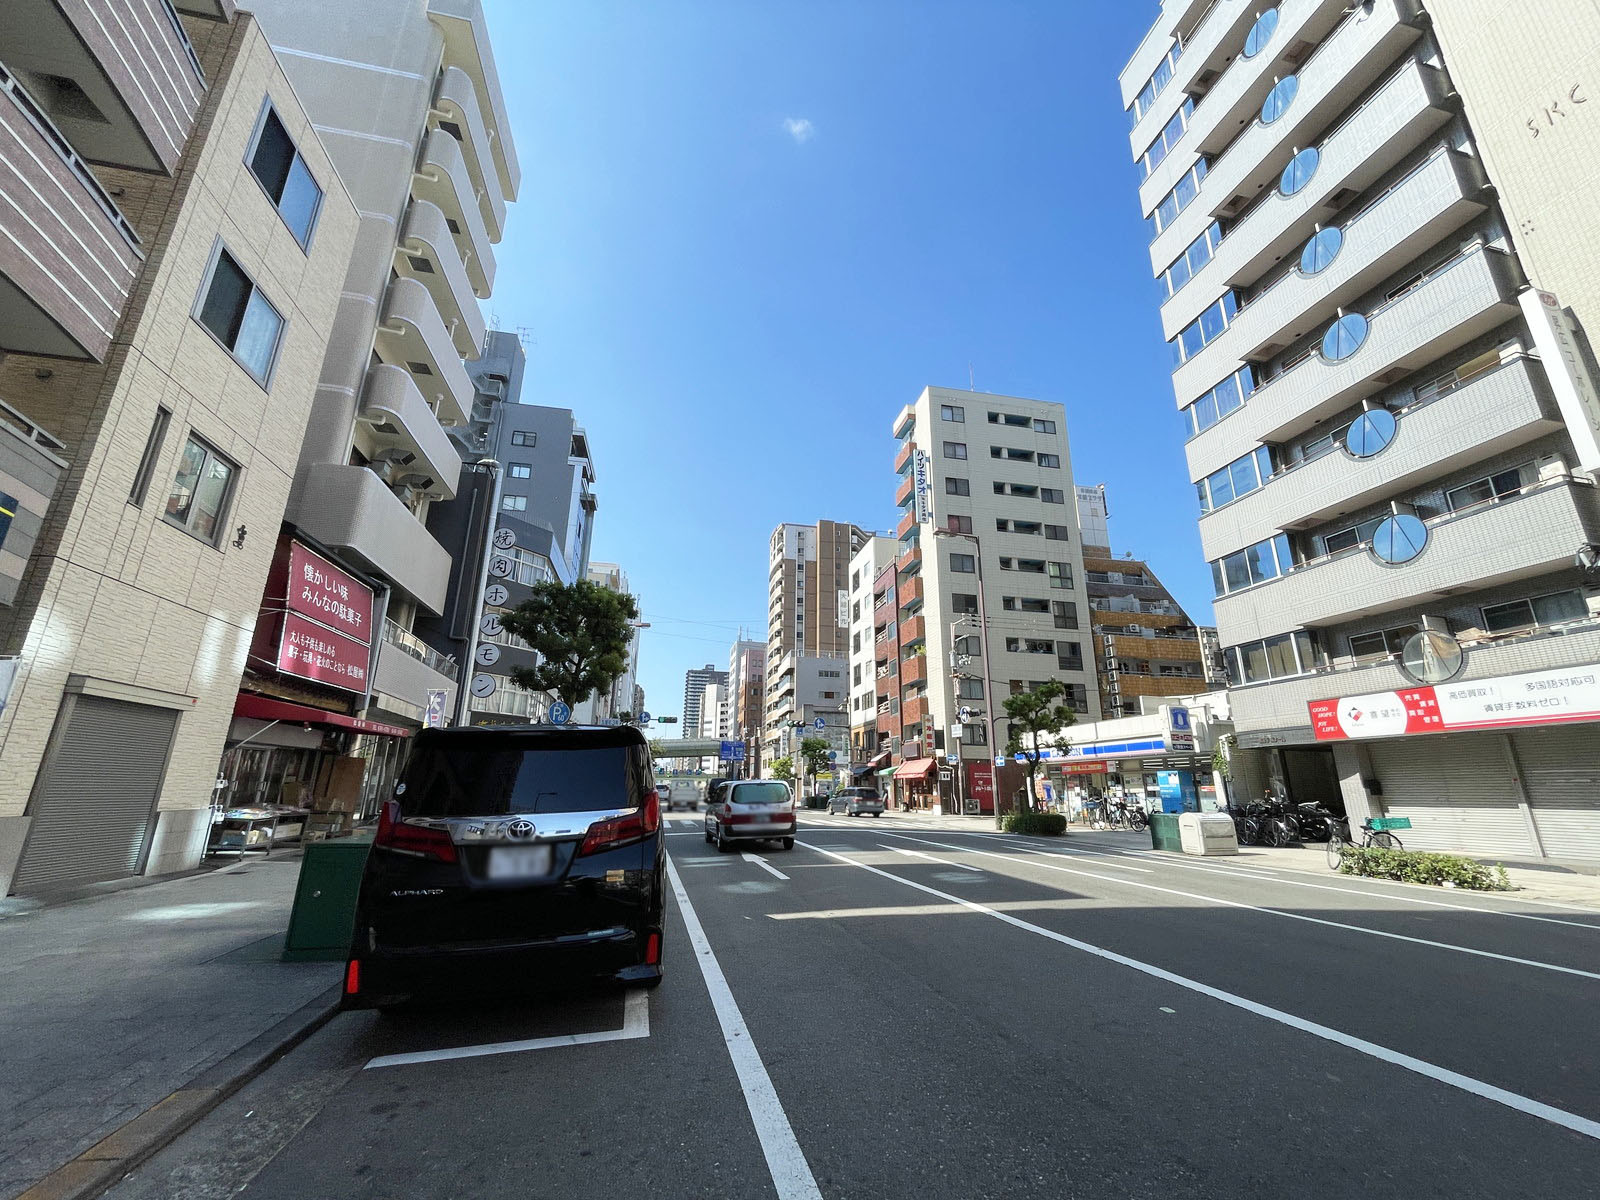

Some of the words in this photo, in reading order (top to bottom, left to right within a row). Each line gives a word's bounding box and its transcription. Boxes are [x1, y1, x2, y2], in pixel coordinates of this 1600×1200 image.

[303, 563, 349, 601] 懐かしい味
[302, 586, 362, 627] みんなの駄菓子
